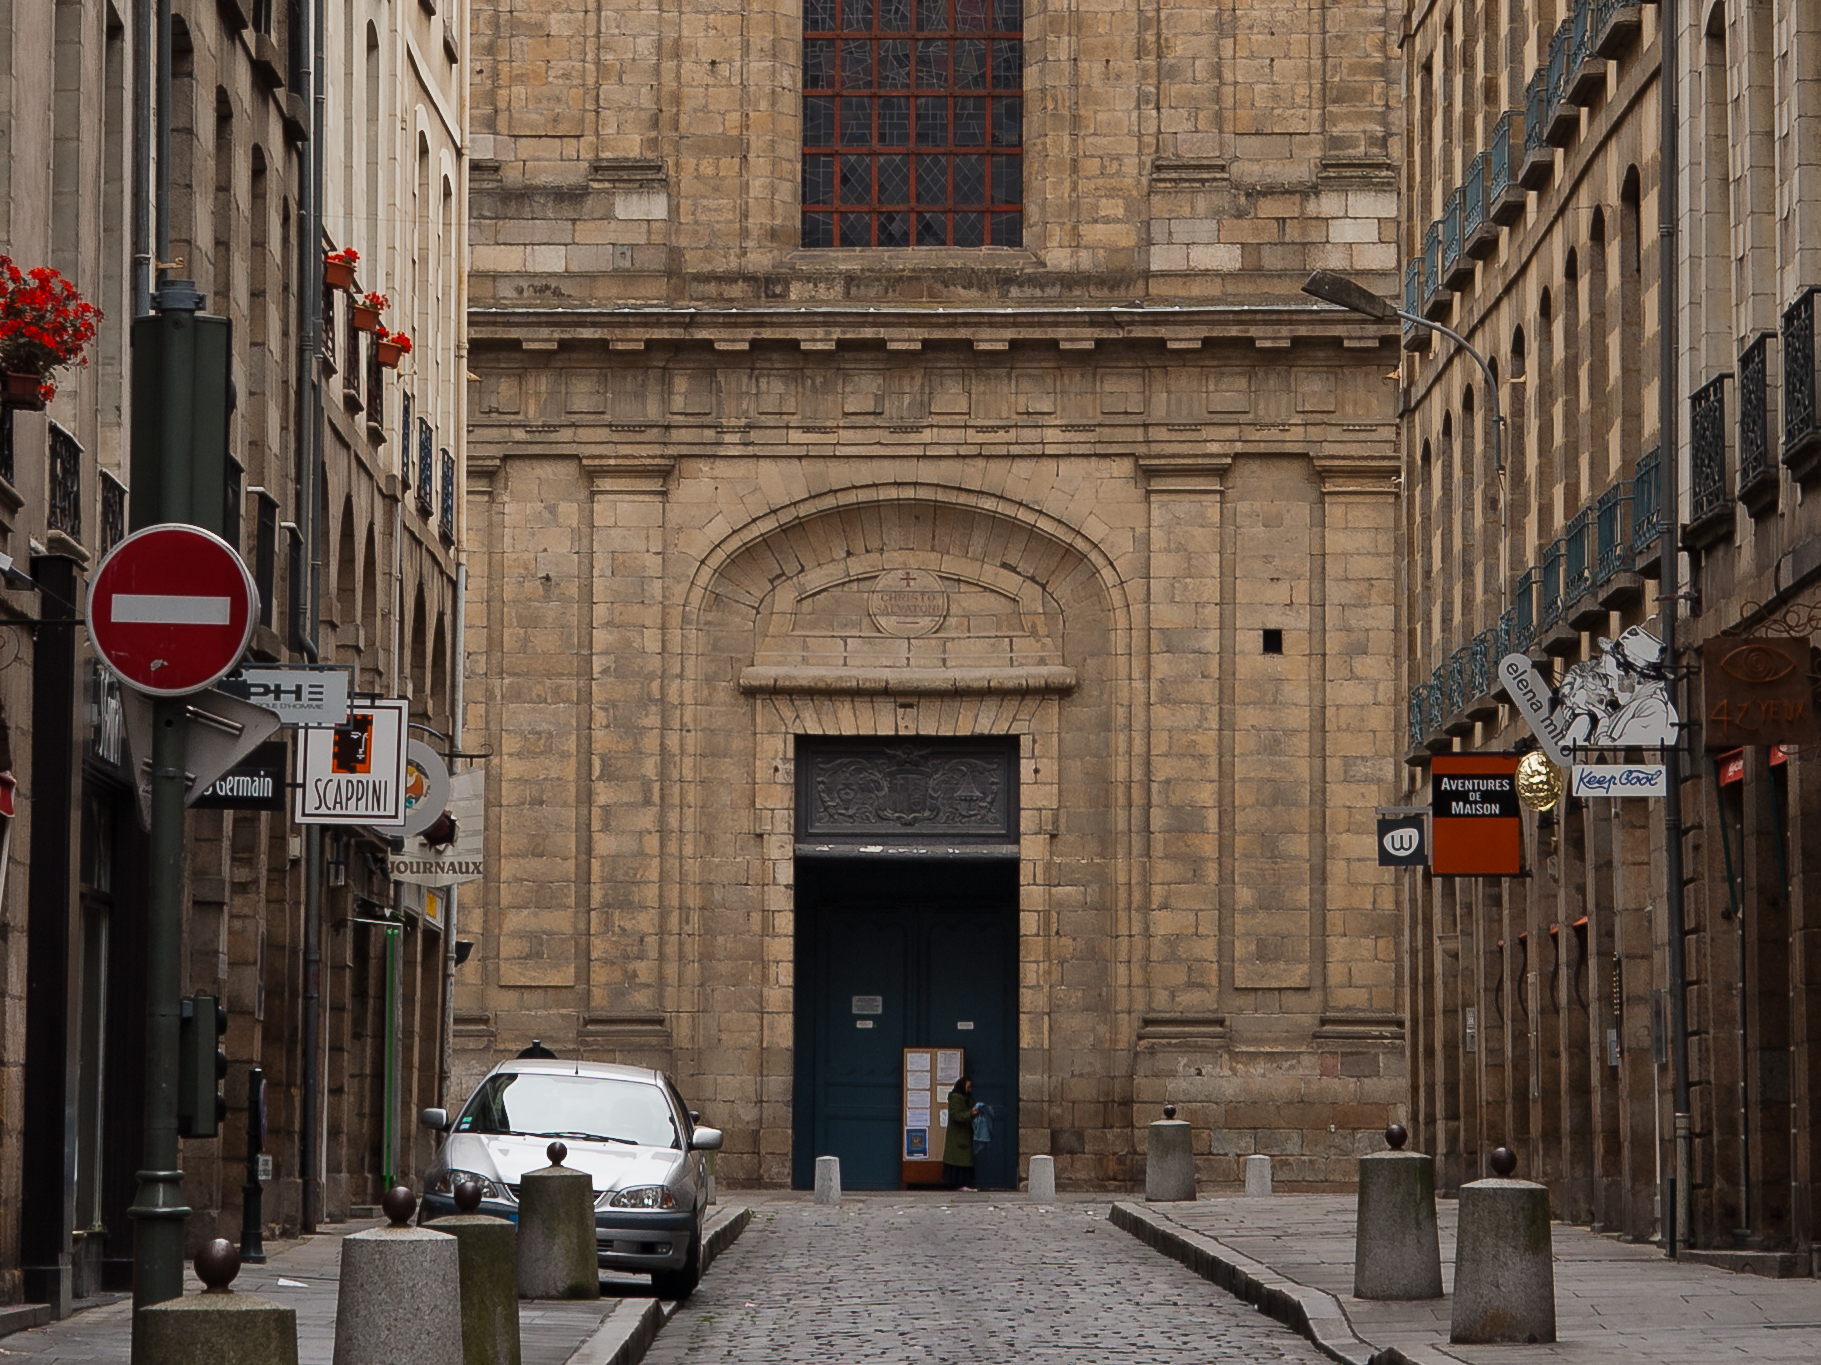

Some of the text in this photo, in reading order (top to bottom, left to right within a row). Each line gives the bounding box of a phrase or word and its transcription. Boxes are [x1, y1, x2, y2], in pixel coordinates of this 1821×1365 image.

[881, 593, 936, 602] CHRISTO
[1506, 662, 1544, 714] elena
[216, 770, 272, 798] Germain
[313, 777, 388, 812] SCAPPINI
[1575, 767, 1663, 795] Keep Cool
[388, 860, 483, 875] JOURNAUX
